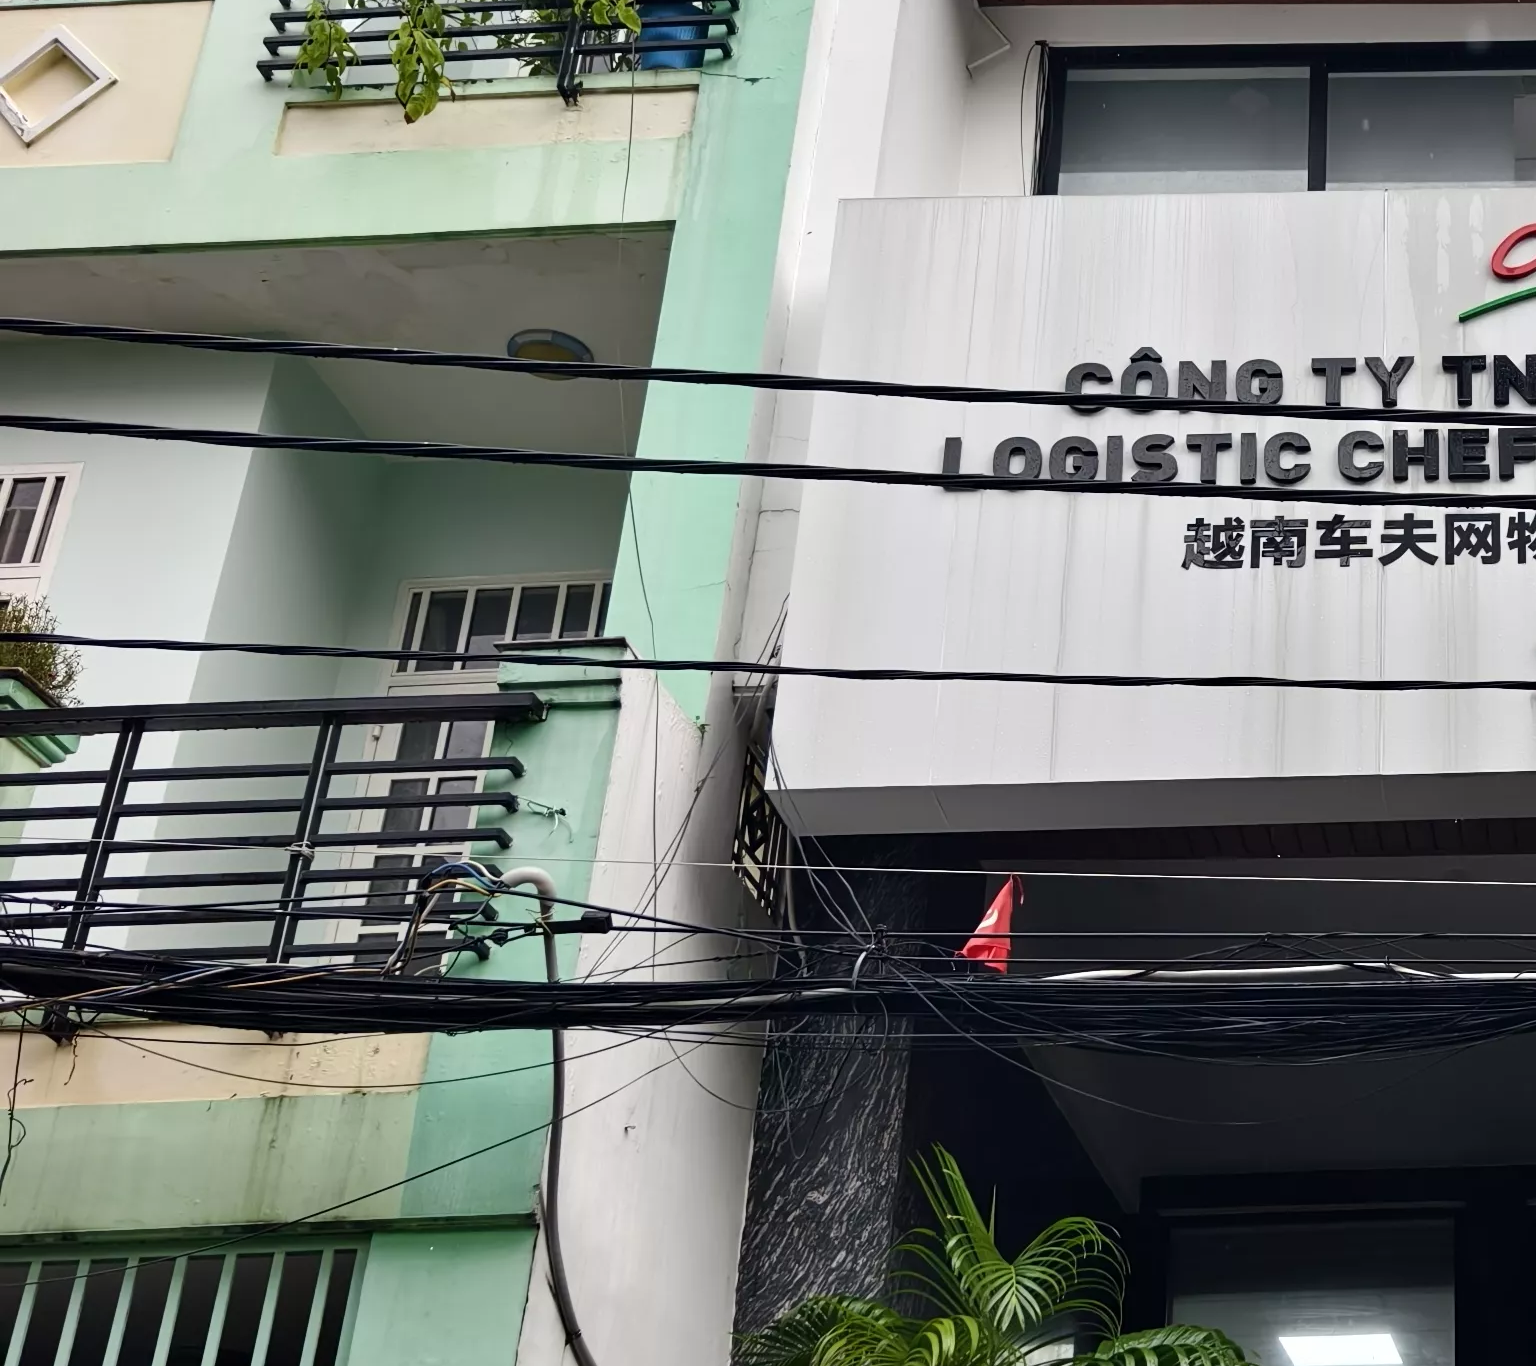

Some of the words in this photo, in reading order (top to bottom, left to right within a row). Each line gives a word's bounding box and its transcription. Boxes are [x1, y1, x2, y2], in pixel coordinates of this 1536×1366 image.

[1064, 346, 1283, 414] CÔNG
[1311, 356, 1414, 408] TY
[942, 429, 1311, 492] LOGISTIC
